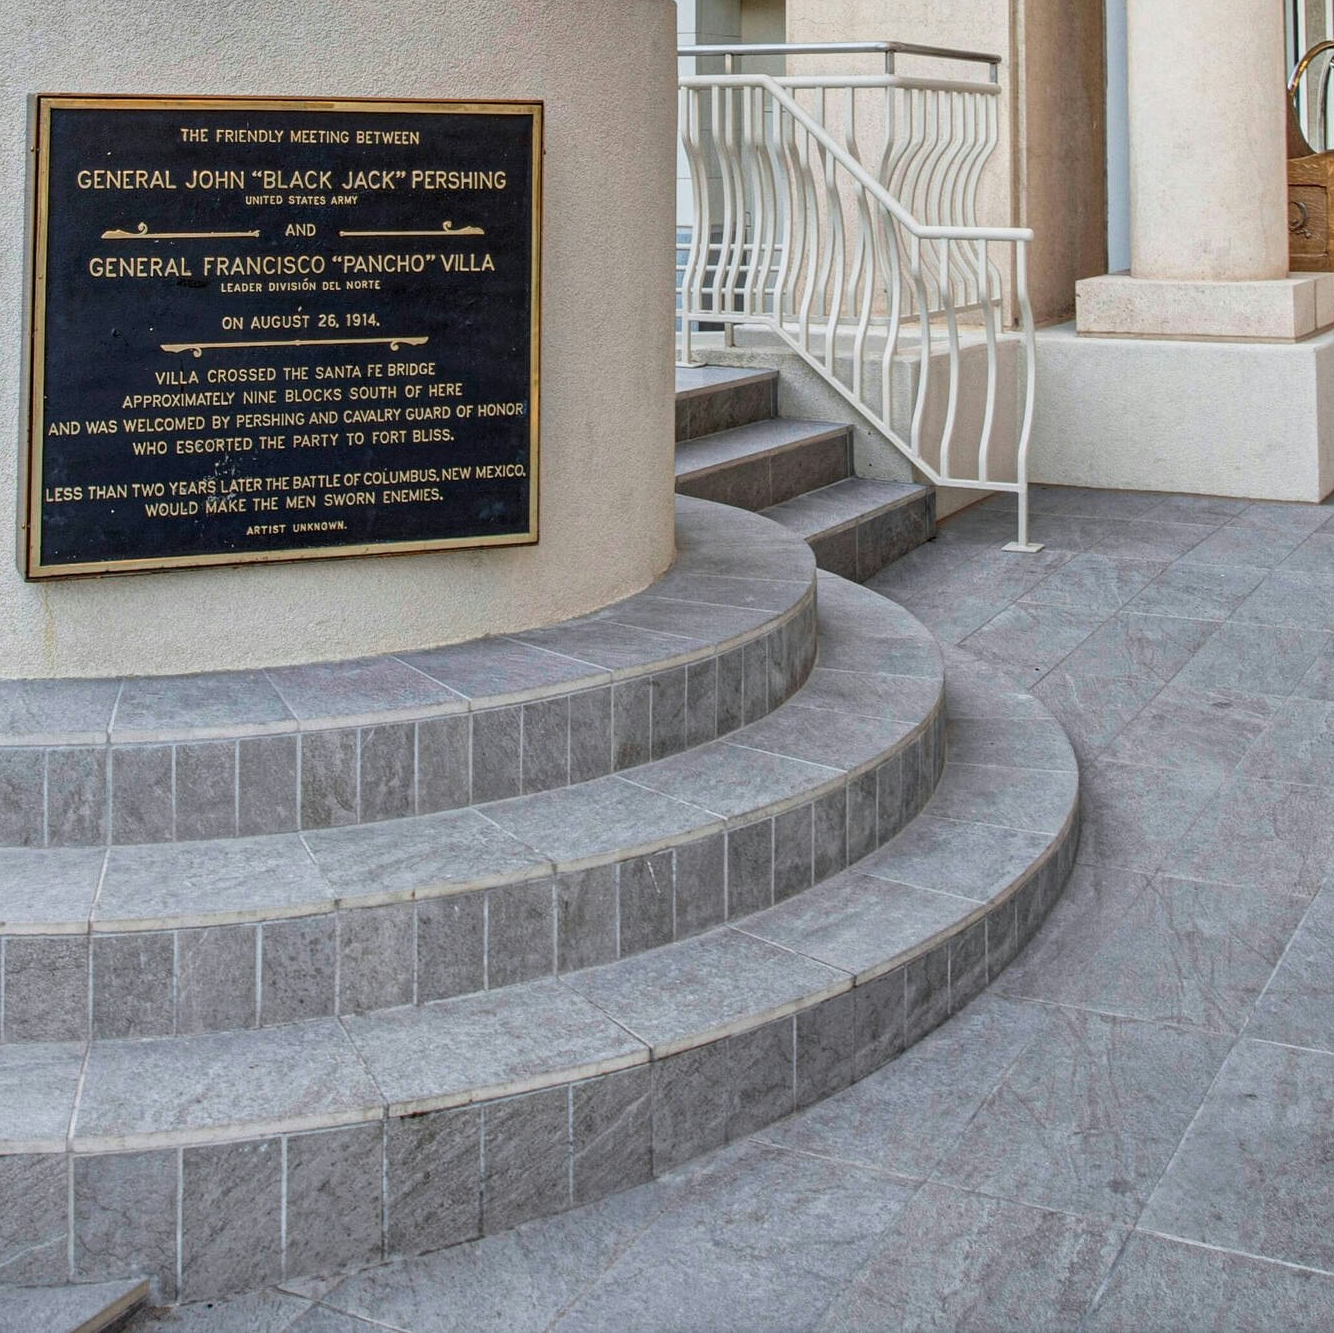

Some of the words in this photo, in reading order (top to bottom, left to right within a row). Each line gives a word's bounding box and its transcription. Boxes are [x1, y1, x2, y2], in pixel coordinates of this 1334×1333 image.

[181, 129, 208, 142] THE
[217, 129, 284, 143] FRIENDLY
[291, 130, 349, 144] MEETING
[356, 131, 420, 144] BETWEEN
[78, 170, 176, 189] GENERAL
[186, 171, 244, 189] JOHN
[252, 170, 332, 189] “BLACK
[342, 171, 406, 189] JACK”
[412, 171, 506, 189] PERSHING
[246, 195, 283, 205] UNITED
[288, 196, 326, 205] STATES
[331, 196, 358, 205] ARMY
[285, 224, 316, 236] AND
[89, 258, 192, 277] GENERAL
[204, 256, 325, 276] FRANCISCO
[332, 255, 436, 273] “PANCHO”
[441, 254, 495, 272] VILLA
[221, 283, 262, 292] LEADER
[269, 278, 316, 291] DIVISIÓN
[323, 282, 341, 290] DEL
[346, 281, 380, 290] NORTE
[222, 317, 243, 330] ON
[251, 315, 309, 328] AUGUST
[318, 315, 339, 328] 26,
[346, 313, 380, 326] 1914.
[156, 371, 199, 385] VILLA
[208, 368, 275, 383] CROSSED
[283, 368, 308, 381] THE
[315, 366, 361, 380] SANTA
[368, 364, 383, 377] FE
[388, 363, 435, 376] BRIDGE
[122, 392, 235, 408] APPROXIMATELY
[243, 391, 277, 404] NINE
[285, 389, 342, 402] BLOCKS
[349, 386, 396, 400] SOUTH
[405, 385, 422, 398] OF
[429, 383, 463, 397] HERE
[48, 422, 80, 436] AND
[86, 420, 117, 435] WAS
[123, 417, 205, 433] WELCOMED
[212, 416, 230, 429] BY
[236, 413, 305, 427] PERSHING
[309, 412, 338, 424] AND
[343, 409, 401, 423] CAVALRY
[406, 406, 450, 420] GUARD
[456, 405, 473, 417] OF
[478, 403, 523, 416] HONOR
[133, 442, 167, 456] WHO
[176, 438, 252, 454] ESCORTED
[259, 436, 285, 449] THE
[293, 434, 339, 448] PARTY
[347, 432, 363, 445] TO
[373, 430, 406, 444] FORT
[413, 429, 454, 442] BLISS.
[46, 487, 83, 502] LESS
[88, 485, 127, 499] THAN
[132, 483, 164, 498] TWO
[169, 480, 216, 495] YEARS
[221, 478, 262, 493] LATER
[266, 477, 289, 490] THE
[293, 474, 341, 489] BATTLE
[344, 473, 361, 486] OF
[442, 467, 471, 481] NEW
[145, 502, 198, 517] WOULD
[206, 499, 246, 513] MAKE
[253, 497, 279, 511] THE
[286, 496, 316, 509] MEN
[324, 492, 375, 506] SWORN
[383, 489, 443, 504] ENEMIES.
[246, 525, 286, 535] ARTIST
[293, 521, 347, 532] UNKNOWN.
